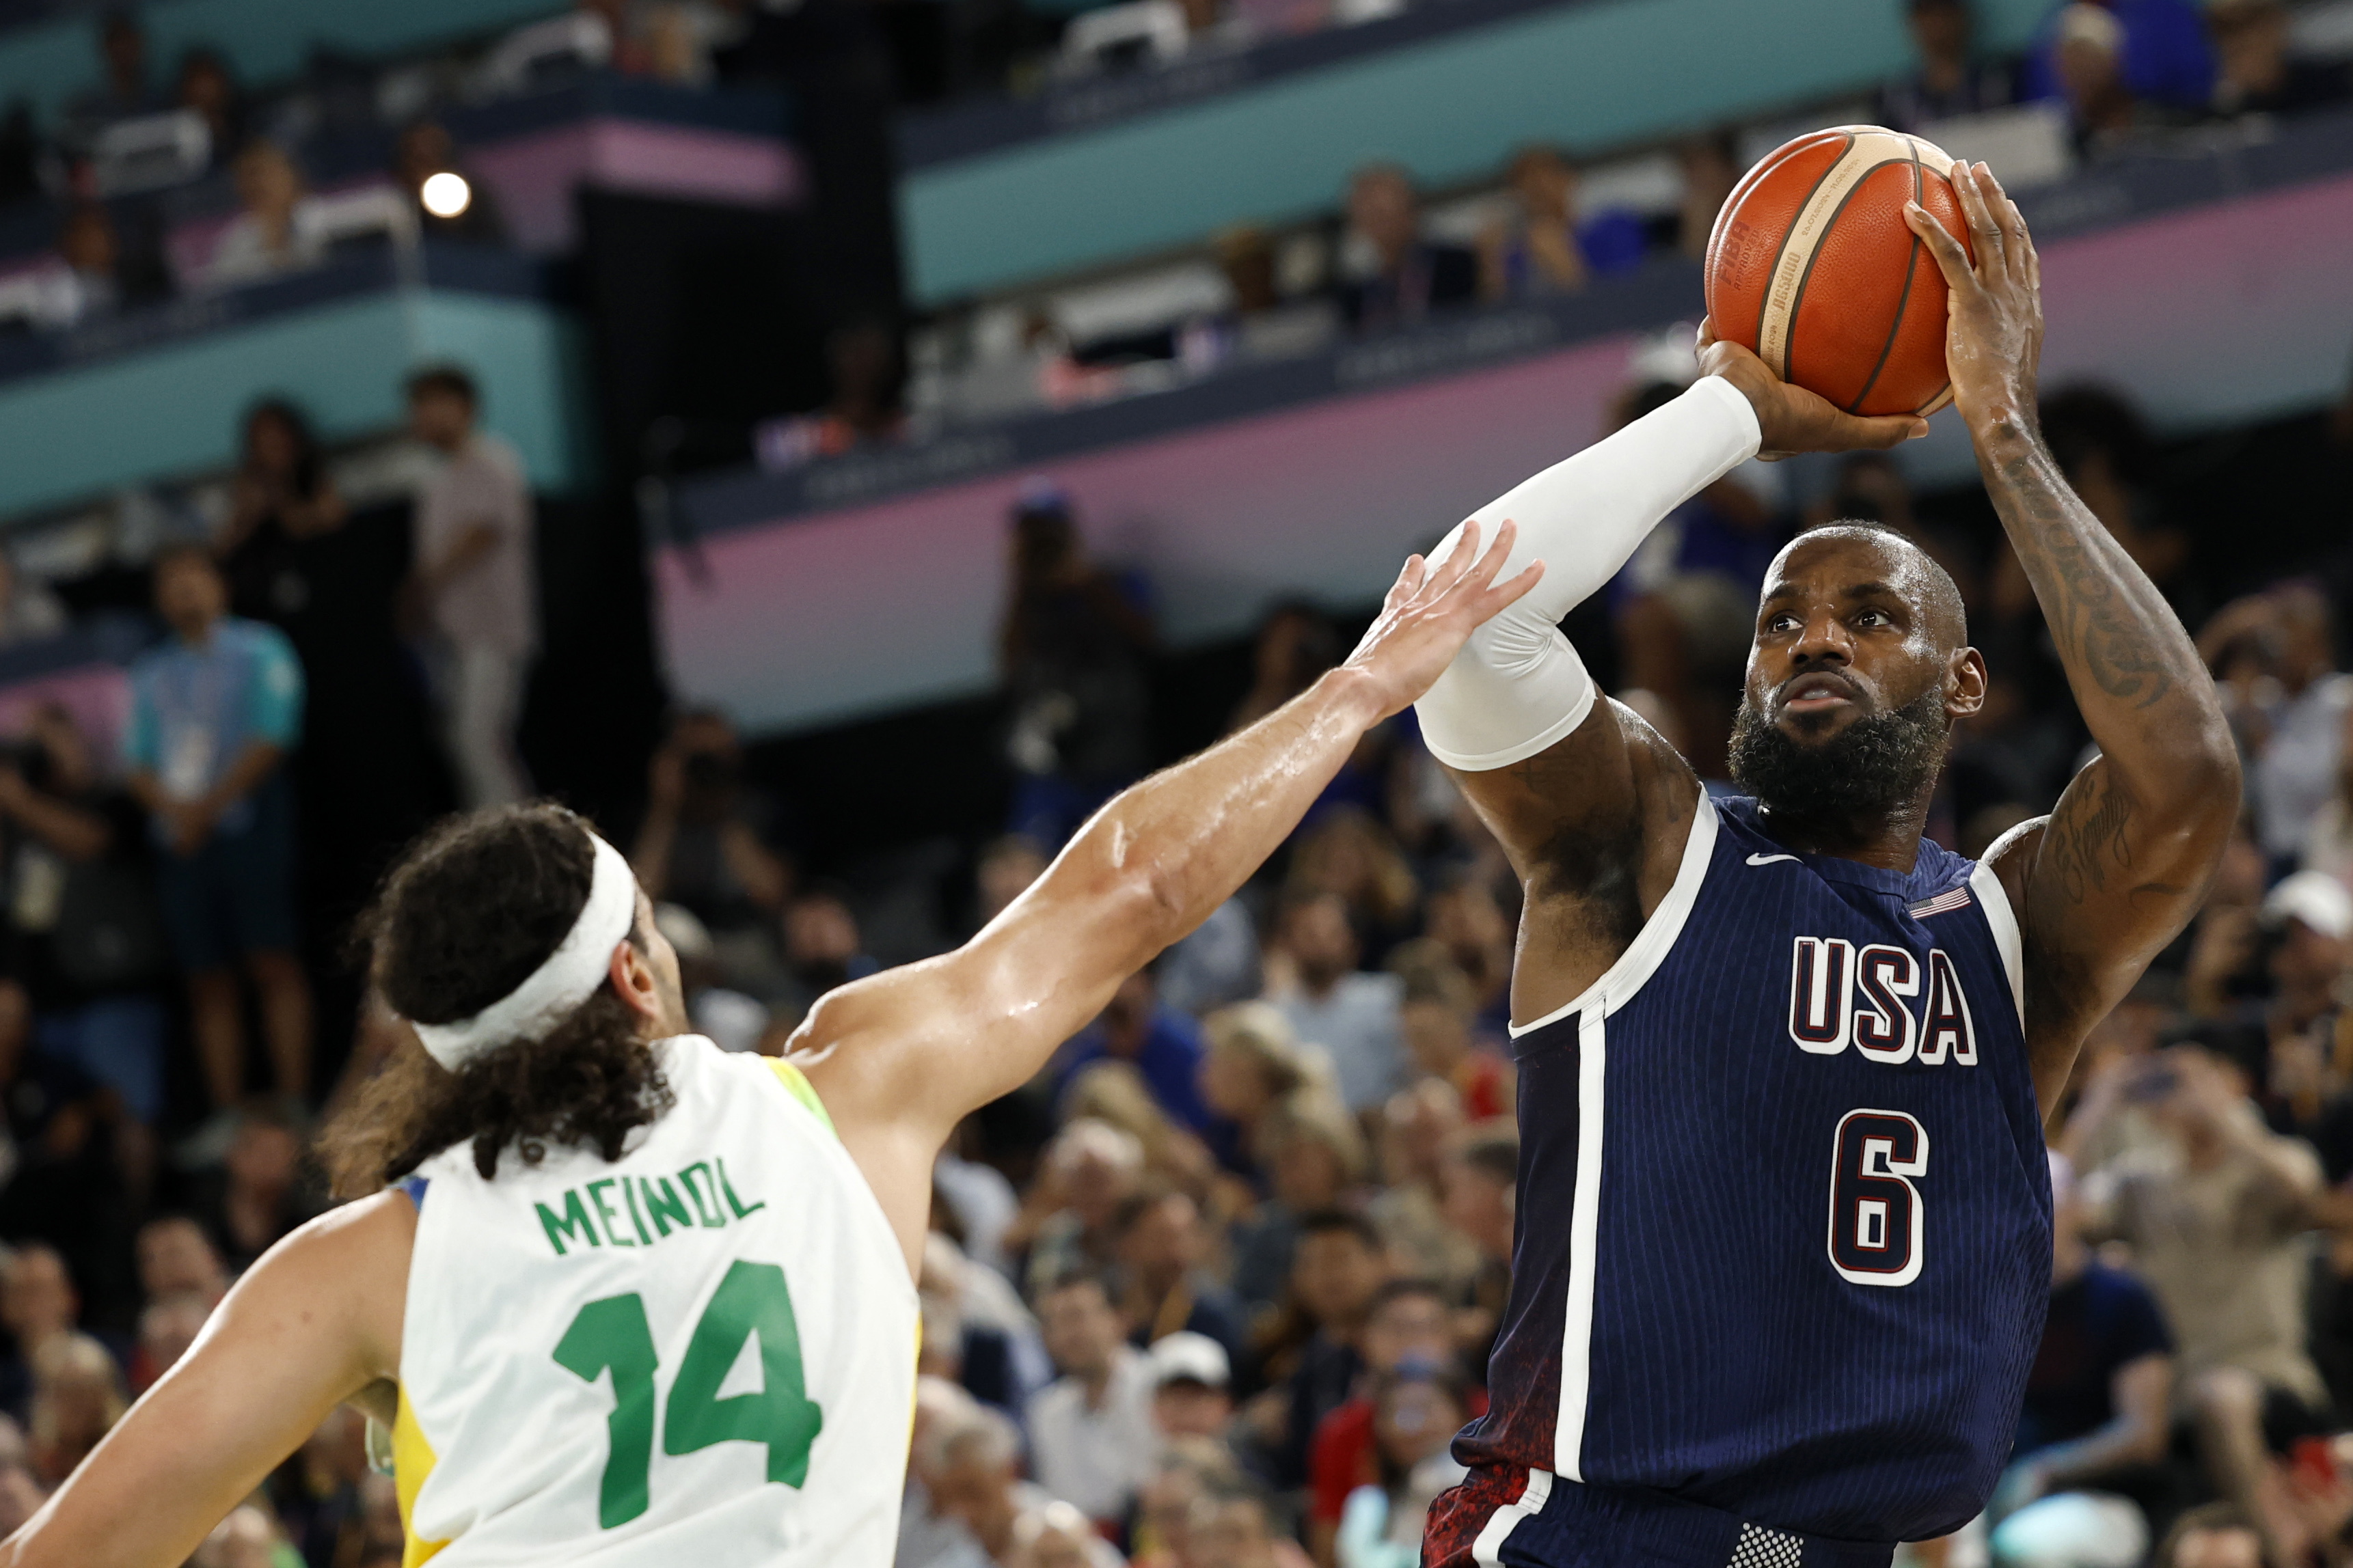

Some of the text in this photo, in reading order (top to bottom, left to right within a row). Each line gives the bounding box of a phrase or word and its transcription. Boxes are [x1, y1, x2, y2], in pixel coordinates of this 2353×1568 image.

[1716, 220, 1750, 286] FIBA
[1734, 228, 1758, 290] APPROVED
[1788, 936, 1978, 1066] USA
[534, 1156, 766, 1255] MEINDL
[1827, 1108, 1929, 1286] 6
[552, 1259, 823, 1530] 14
